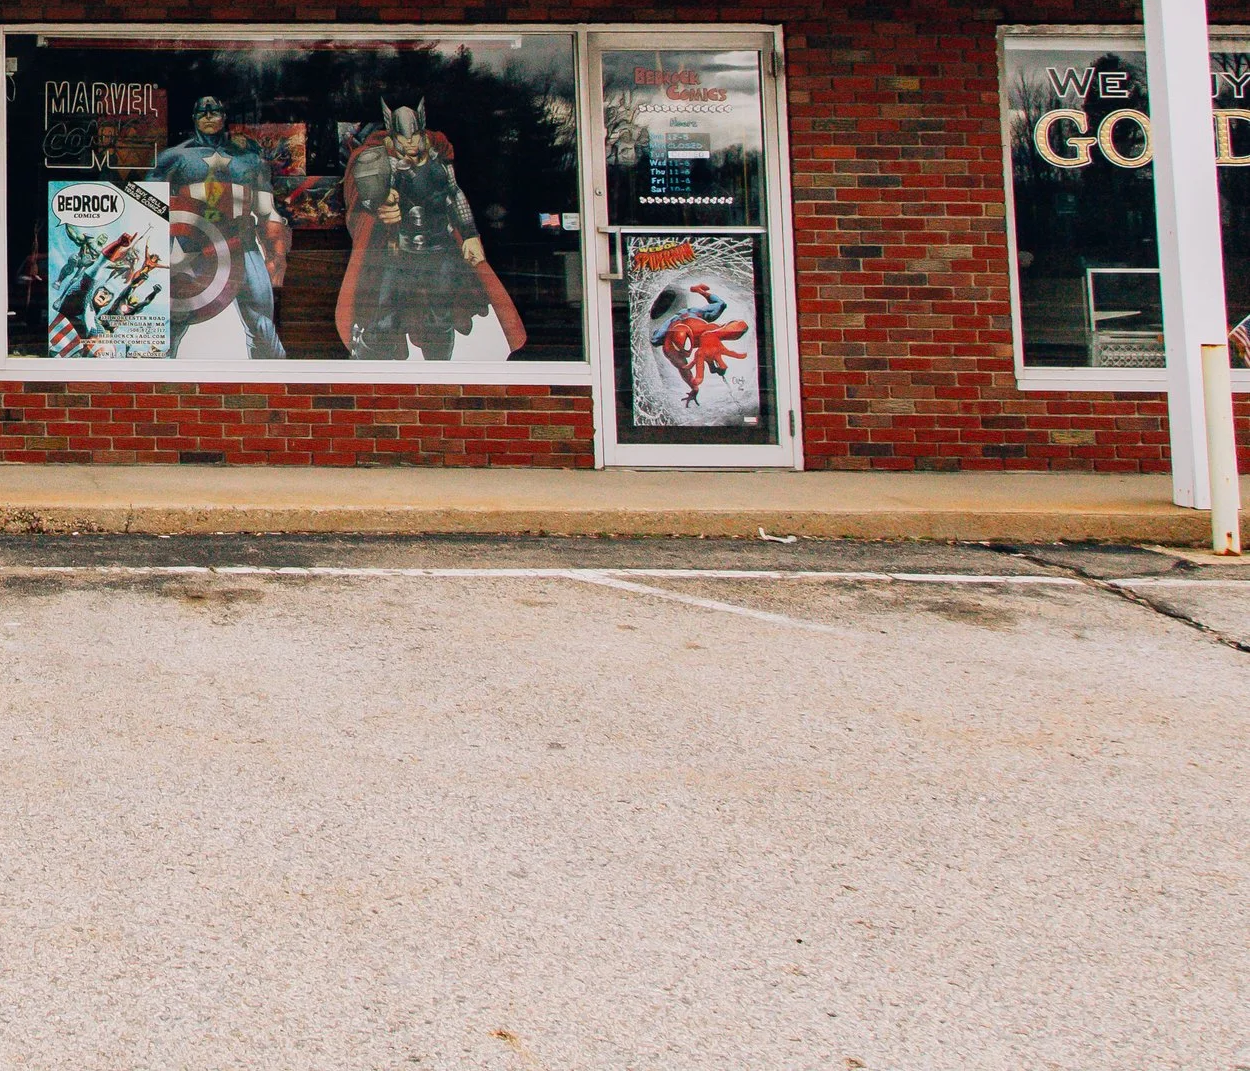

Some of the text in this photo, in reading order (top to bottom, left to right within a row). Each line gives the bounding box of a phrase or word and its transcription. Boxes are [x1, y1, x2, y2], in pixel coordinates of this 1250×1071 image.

[45, 81, 158, 117] MARVEL
[1047, 67, 1129, 98] WE
[1034, 109, 1250, 168] GOD
[58, 195, 118, 212] BEDROCK
